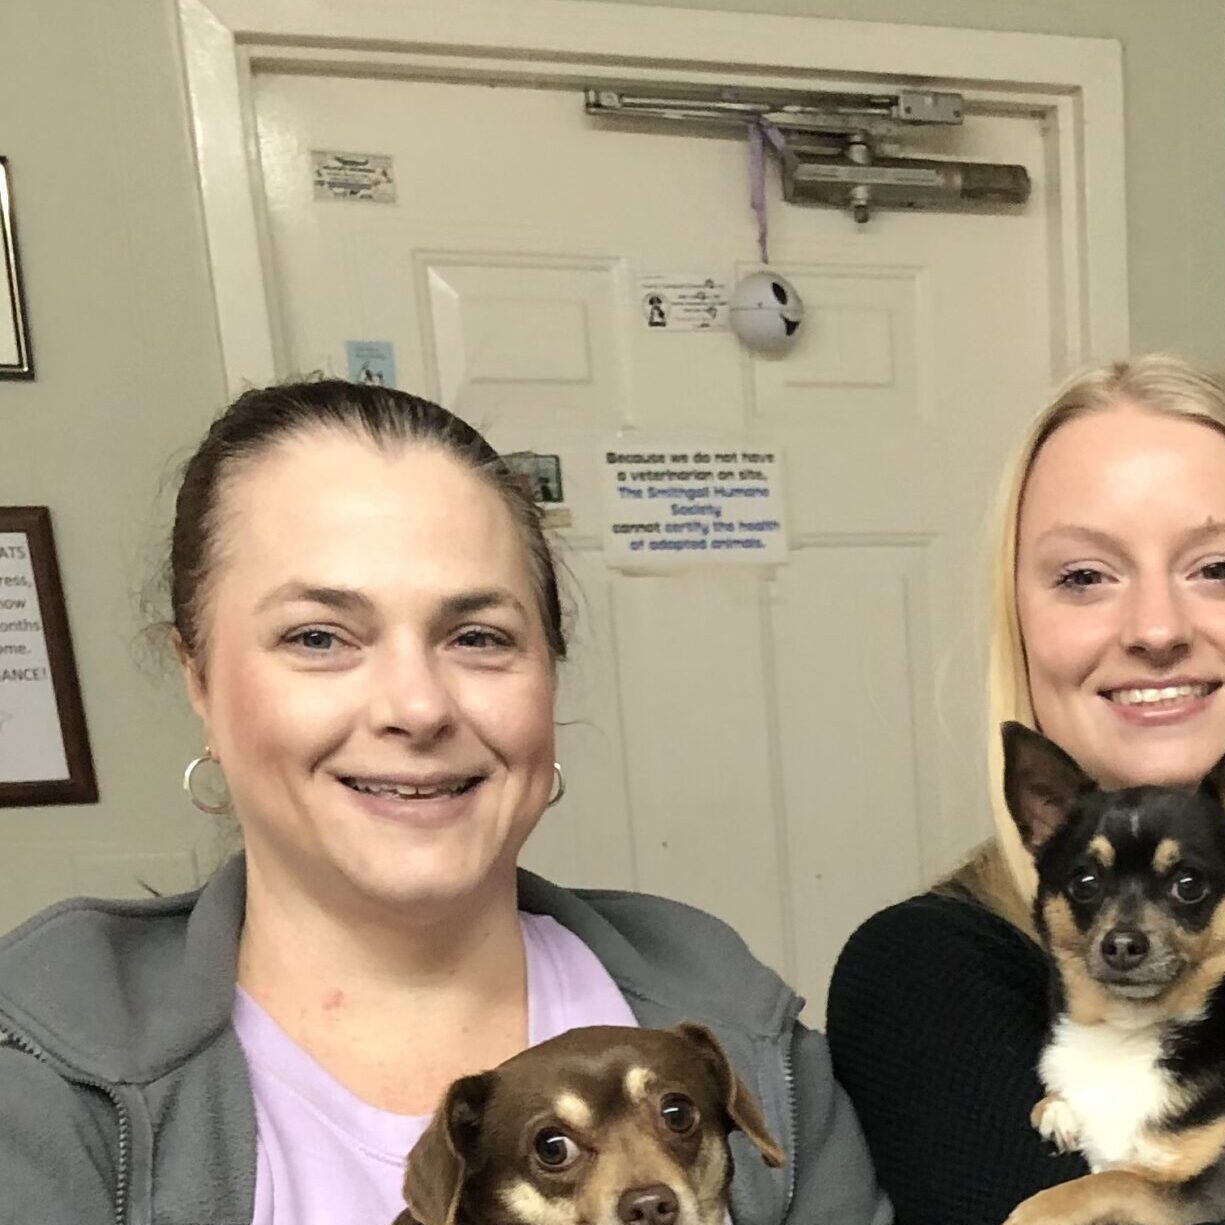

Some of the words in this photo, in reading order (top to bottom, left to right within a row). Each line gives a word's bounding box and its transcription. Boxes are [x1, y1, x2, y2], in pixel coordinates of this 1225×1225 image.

[606, 452, 665, 464] Because
[669, 454, 688, 463] we
[692, 452, 710, 464] do
[714, 453, 737, 463] not
[742, 453, 774, 463] have
[617, 472, 626, 481] a
[630, 470, 713, 481] veterinarian
[717, 472, 734, 481] on
[617, 487, 643, 498] The
[713, 487, 769, 498] Humane
[671, 504, 721, 518] Society
[612, 523, 660, 533] cannot
[712, 522, 735, 532] the
[739, 521, 780, 532] health
[630, 540, 644, 550] of
[648, 539, 707, 552] adopted
[0, 667, 46, 681] ANCE!
